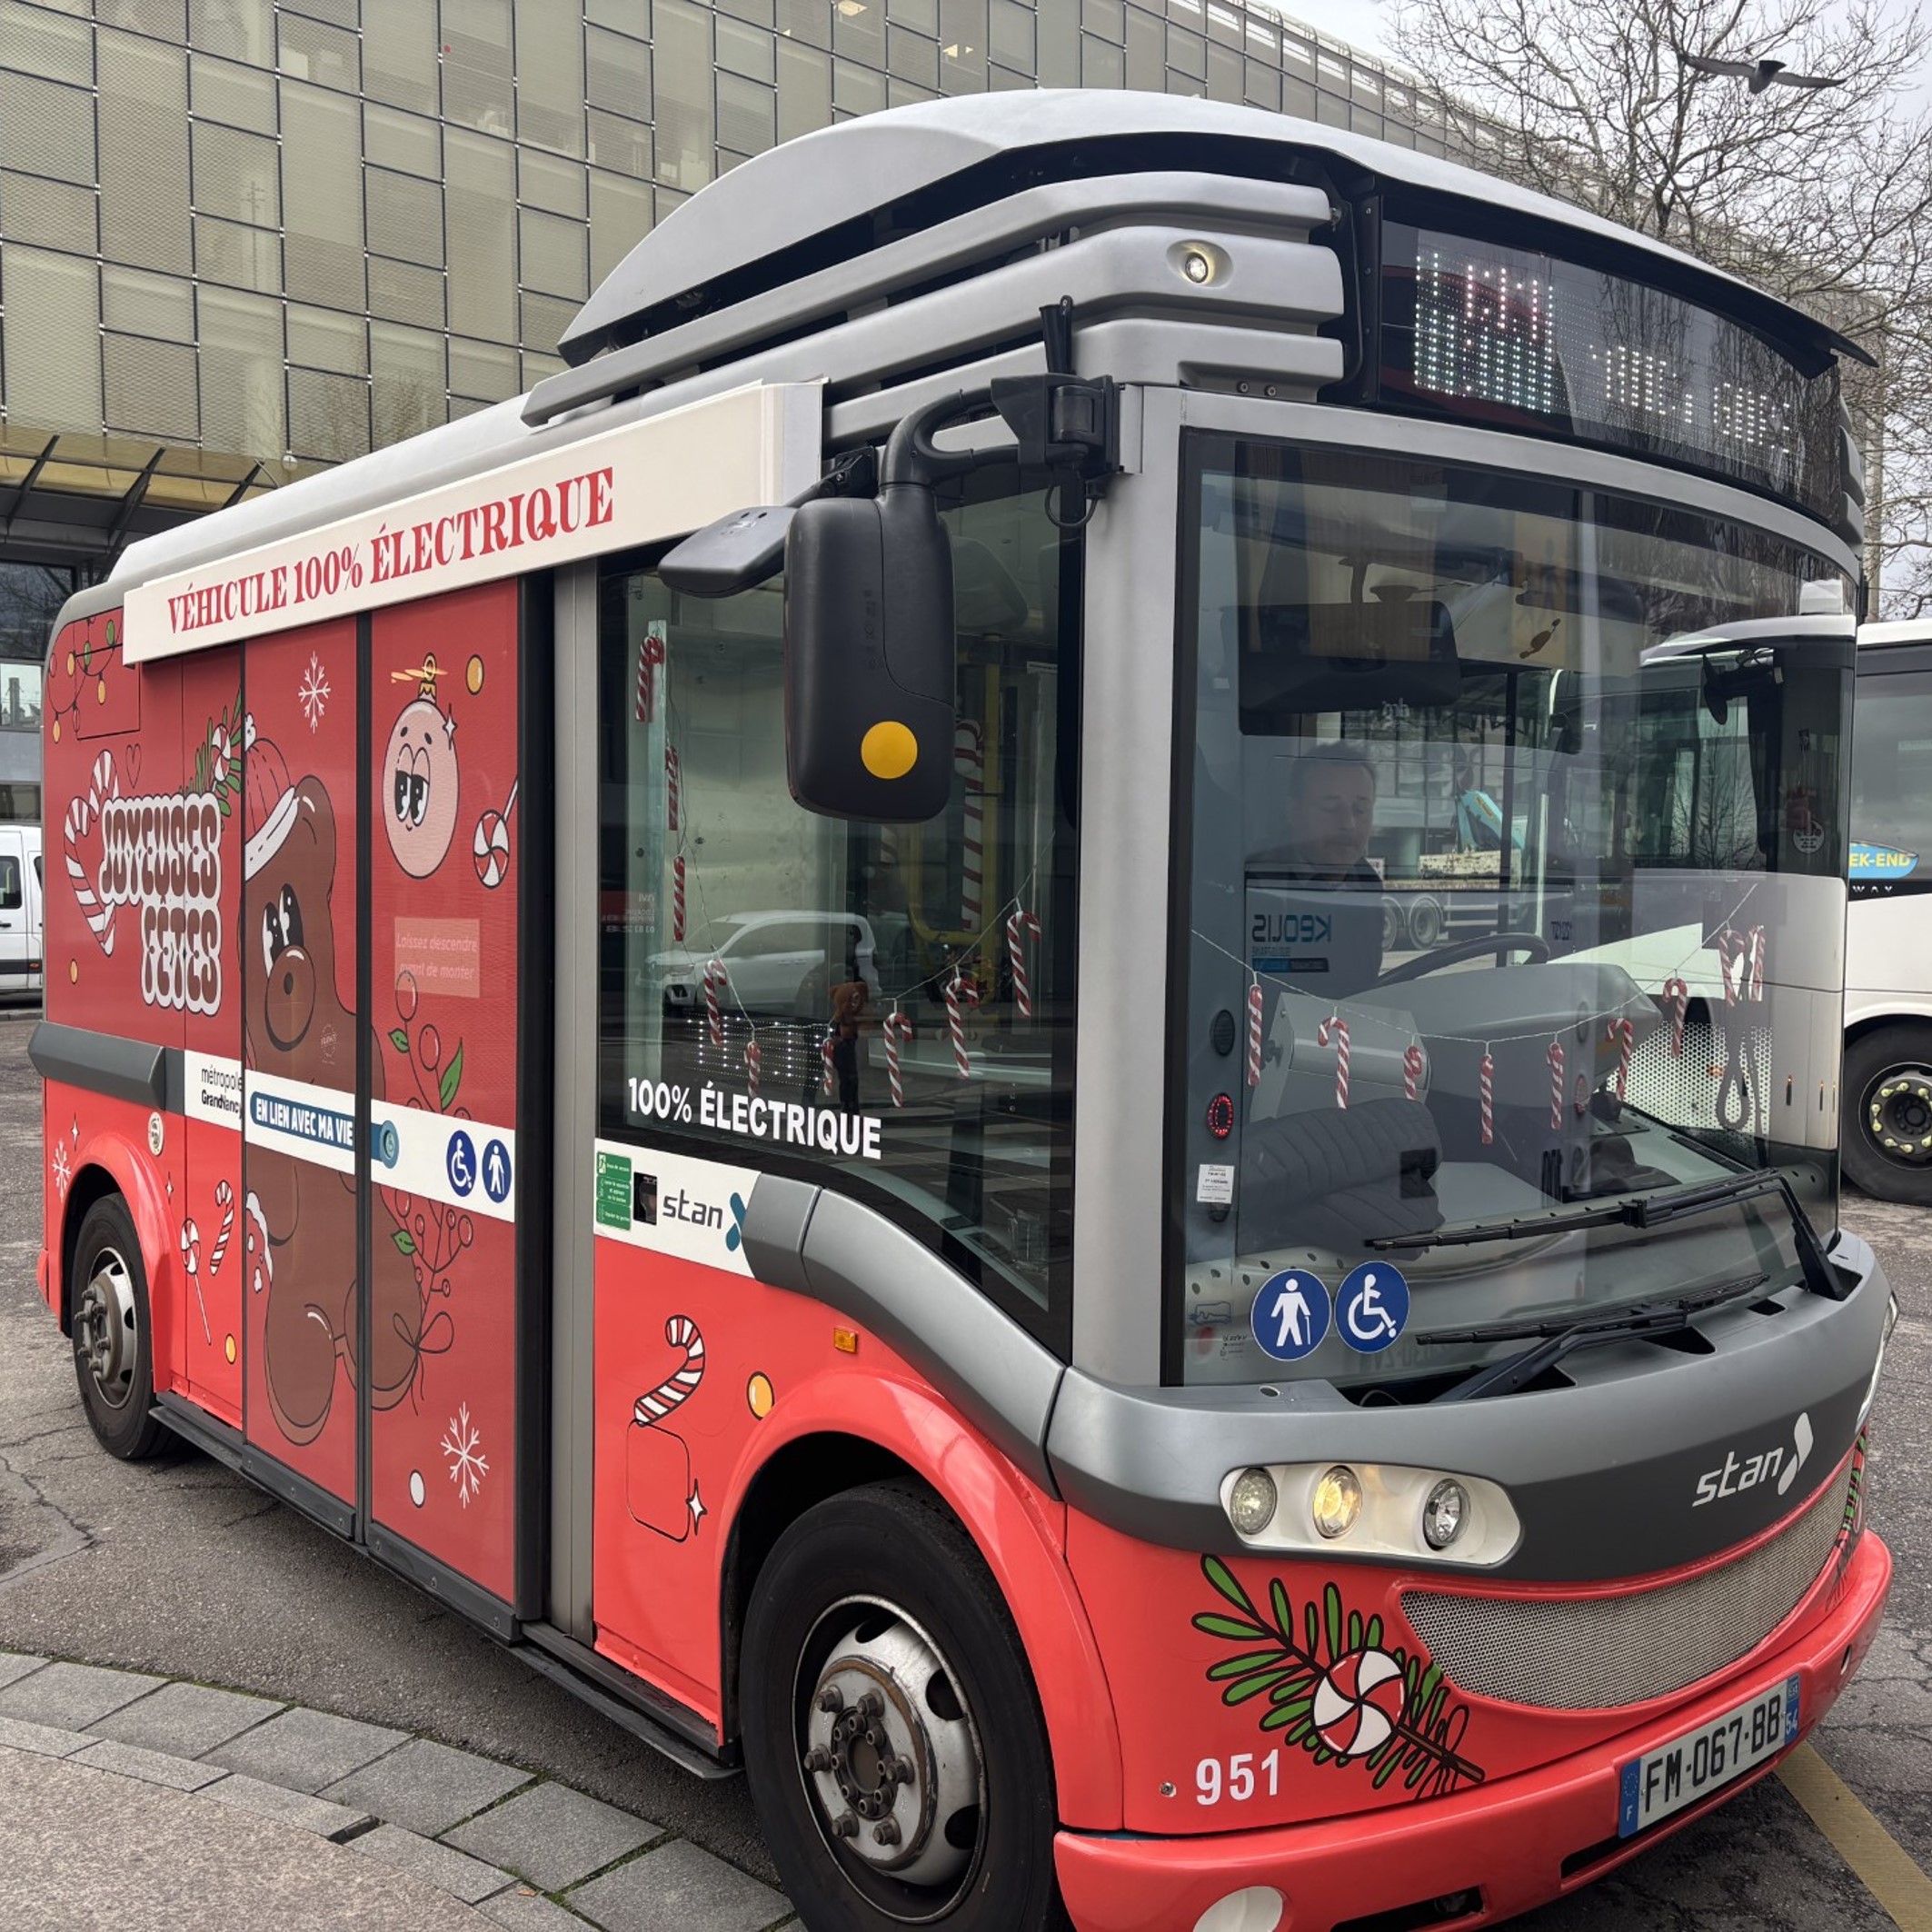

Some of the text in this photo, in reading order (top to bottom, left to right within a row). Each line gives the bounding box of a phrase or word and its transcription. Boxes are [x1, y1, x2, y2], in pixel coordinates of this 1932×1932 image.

[168, 466, 613, 634] VÉHICULE 100% ÉLECTRIQUE
[100, 801, 219, 901] JOYEUSES
[429, 936, 478, 952] descendre
[255, 1098, 354, 1147] EN LIEN AVEC MA VIE
[628, 1077, 881, 1160] 100% ÉLECTRIQUE
[662, 1189, 723, 1230] stan
[1692, 1447, 1784, 1508] stan
[1196, 1748, 1279, 1806] 951
[1645, 1694, 1781, 1813] FM-067-BB
